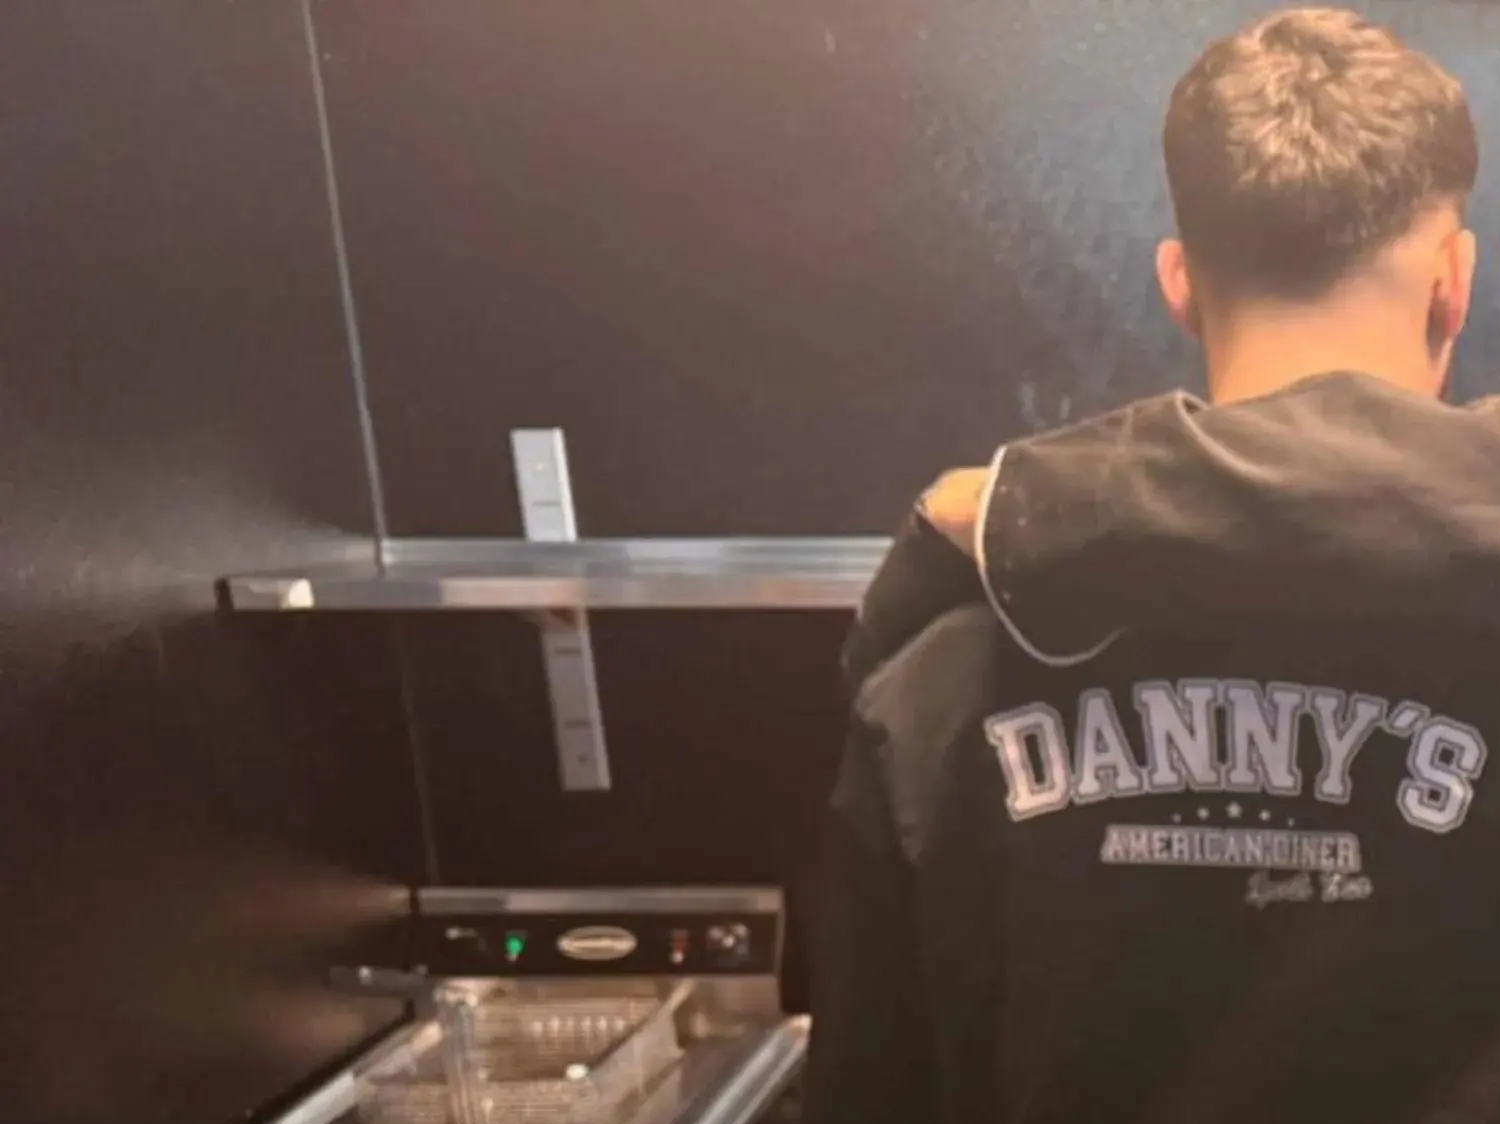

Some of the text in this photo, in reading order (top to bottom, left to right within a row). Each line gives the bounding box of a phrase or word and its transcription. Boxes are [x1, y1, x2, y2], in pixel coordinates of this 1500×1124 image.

[984, 678, 1488, 833] DANNY'S
[1101, 825, 1361, 871] AMERICAN DINER
